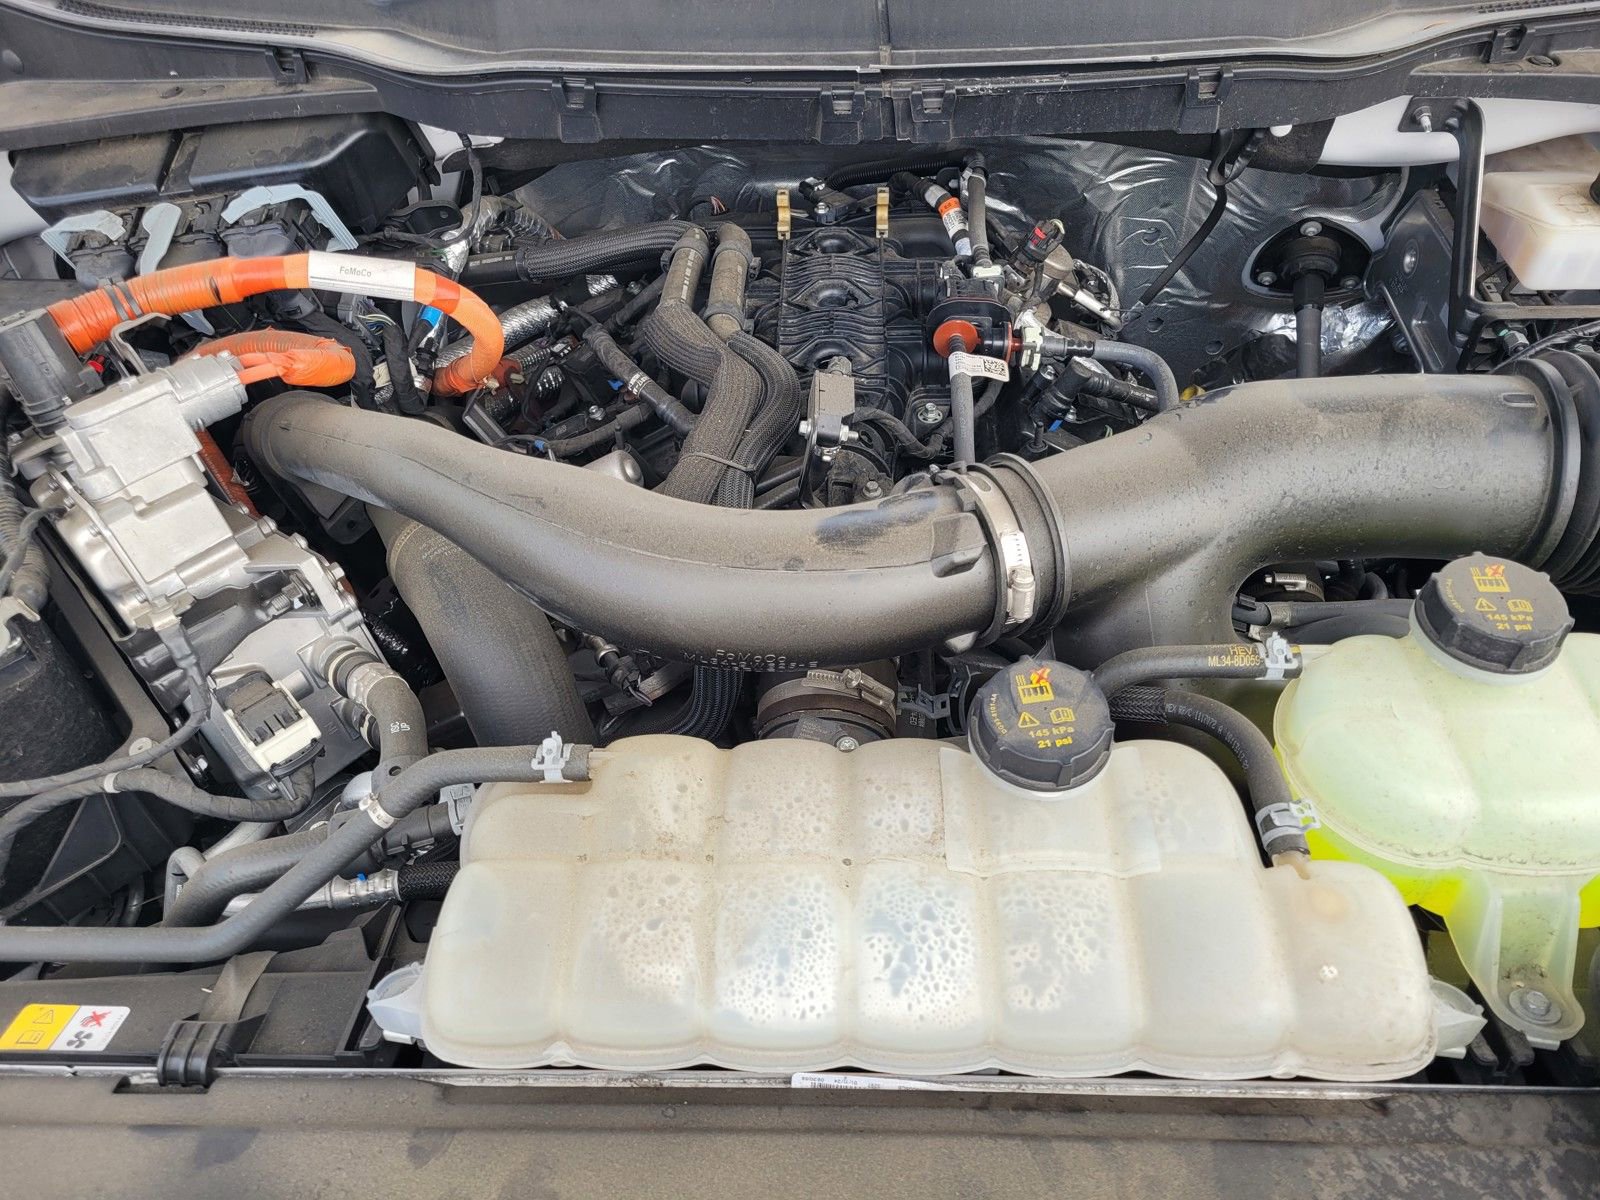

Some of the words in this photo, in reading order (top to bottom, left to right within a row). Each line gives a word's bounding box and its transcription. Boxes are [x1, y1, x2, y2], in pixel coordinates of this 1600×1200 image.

[340, 266, 371, 277] FoMoCo
[716, 649, 786, 662] FoMoCo
[1229, 646, 1253, 655] HEV
[400, 722, 410, 731] UP
[1029, 729, 1049, 738] 145
[1038, 740, 1052, 748] 21
[1055, 736, 1073, 747] psi
